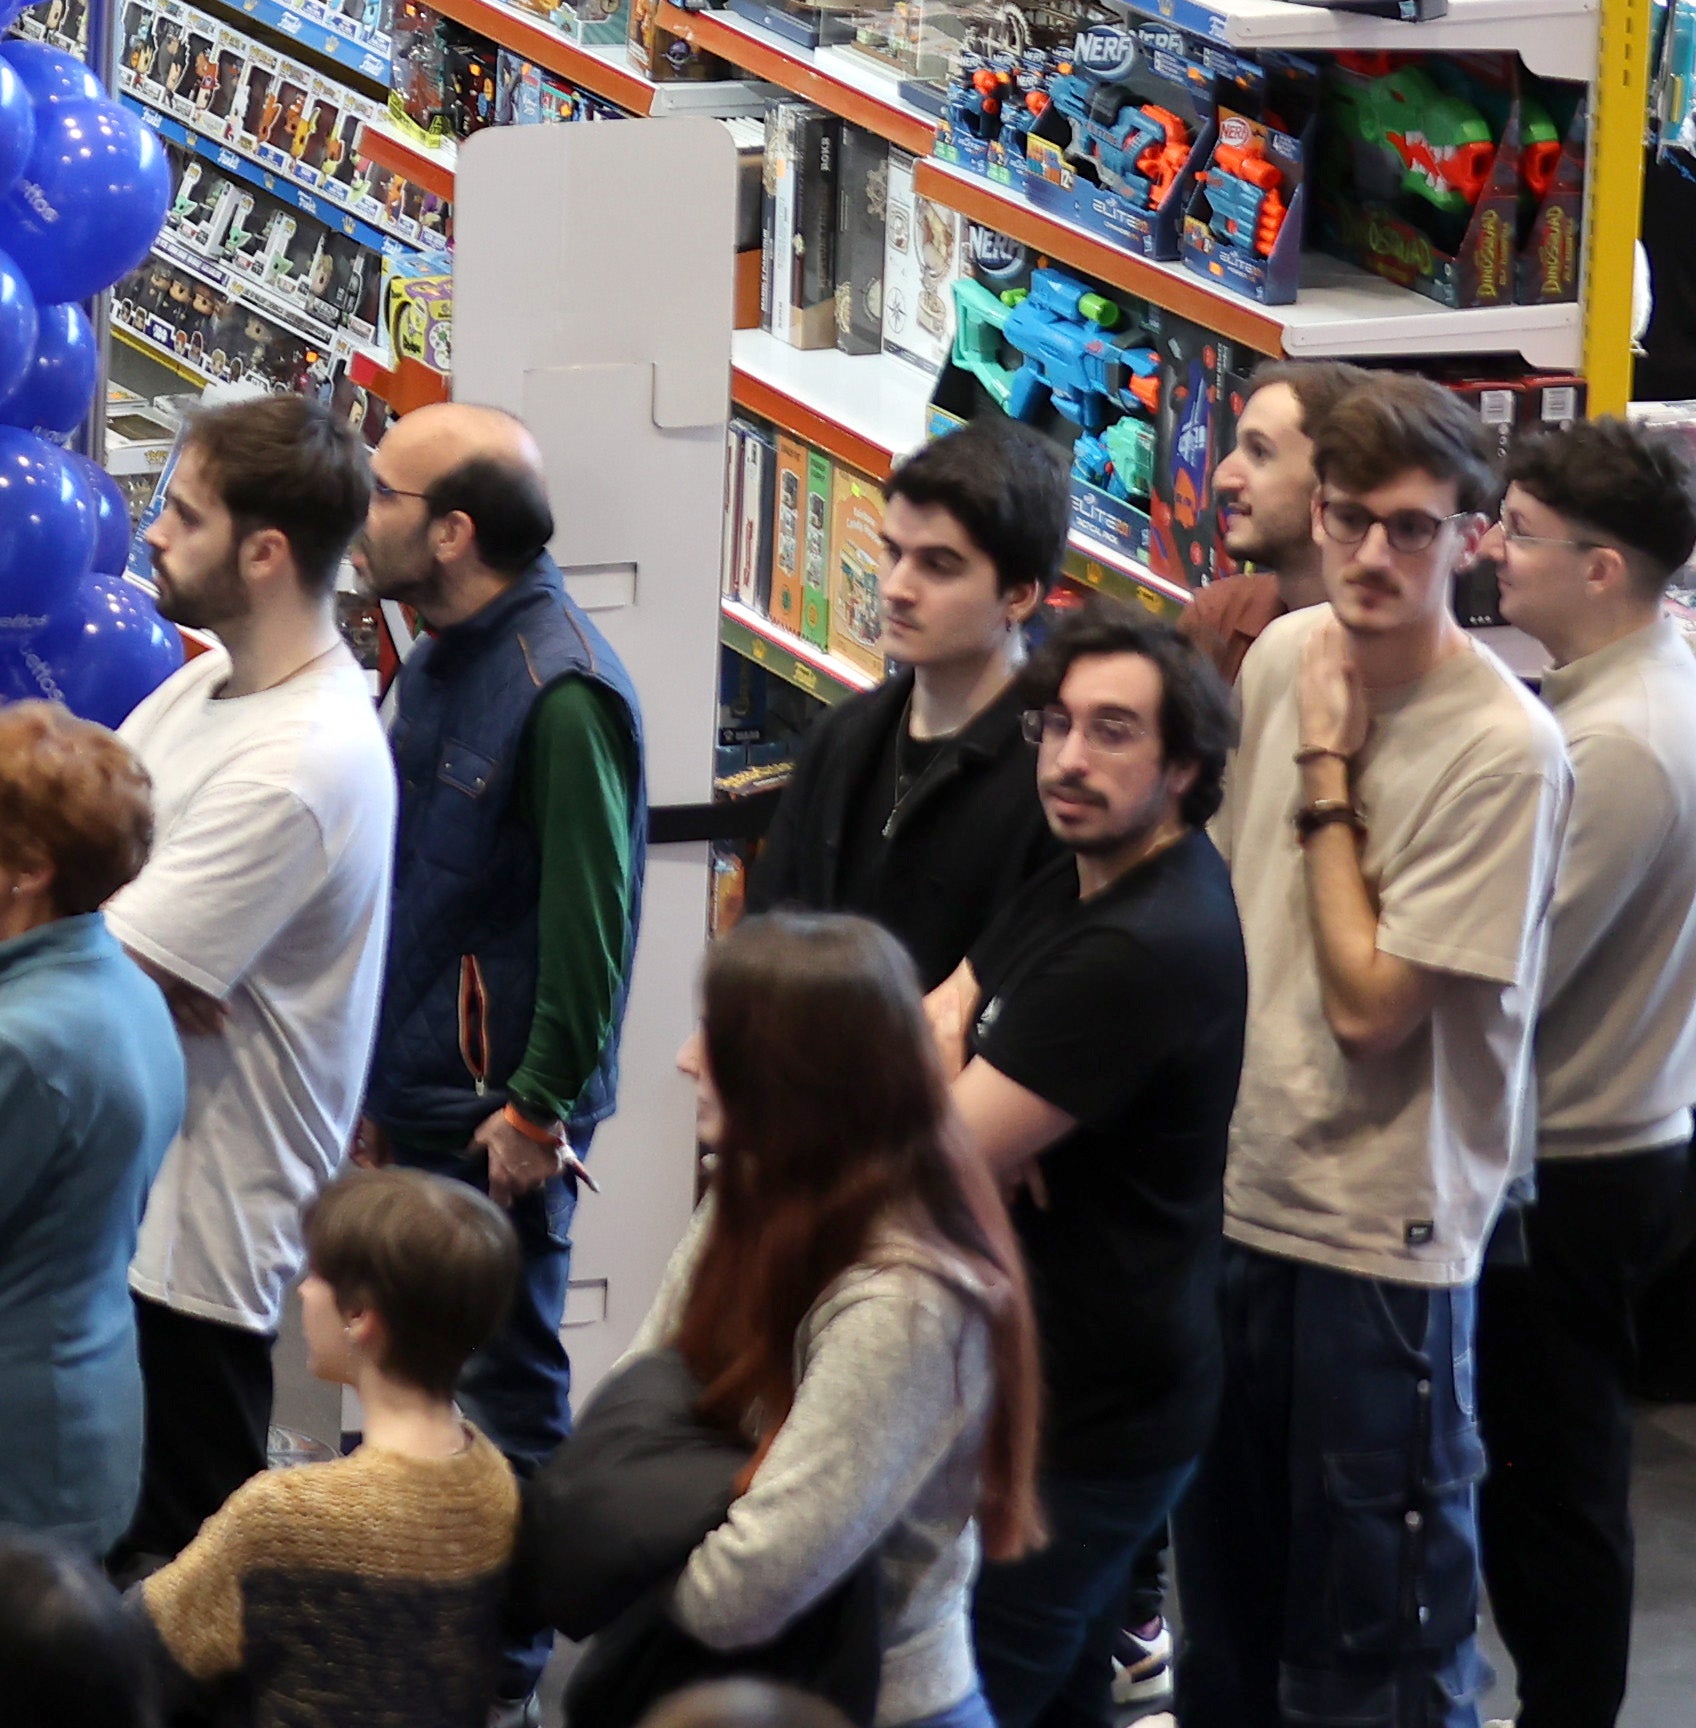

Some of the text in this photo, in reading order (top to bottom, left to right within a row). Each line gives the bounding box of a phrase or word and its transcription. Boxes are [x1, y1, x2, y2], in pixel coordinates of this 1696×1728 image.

[1075, 31, 1132, 64] NERF
[1220, 122, 1251, 142] NERF
[1474, 208, 1500, 299] DINOSQUAD
[1538, 205, 1564, 295] DINOSQUAD
